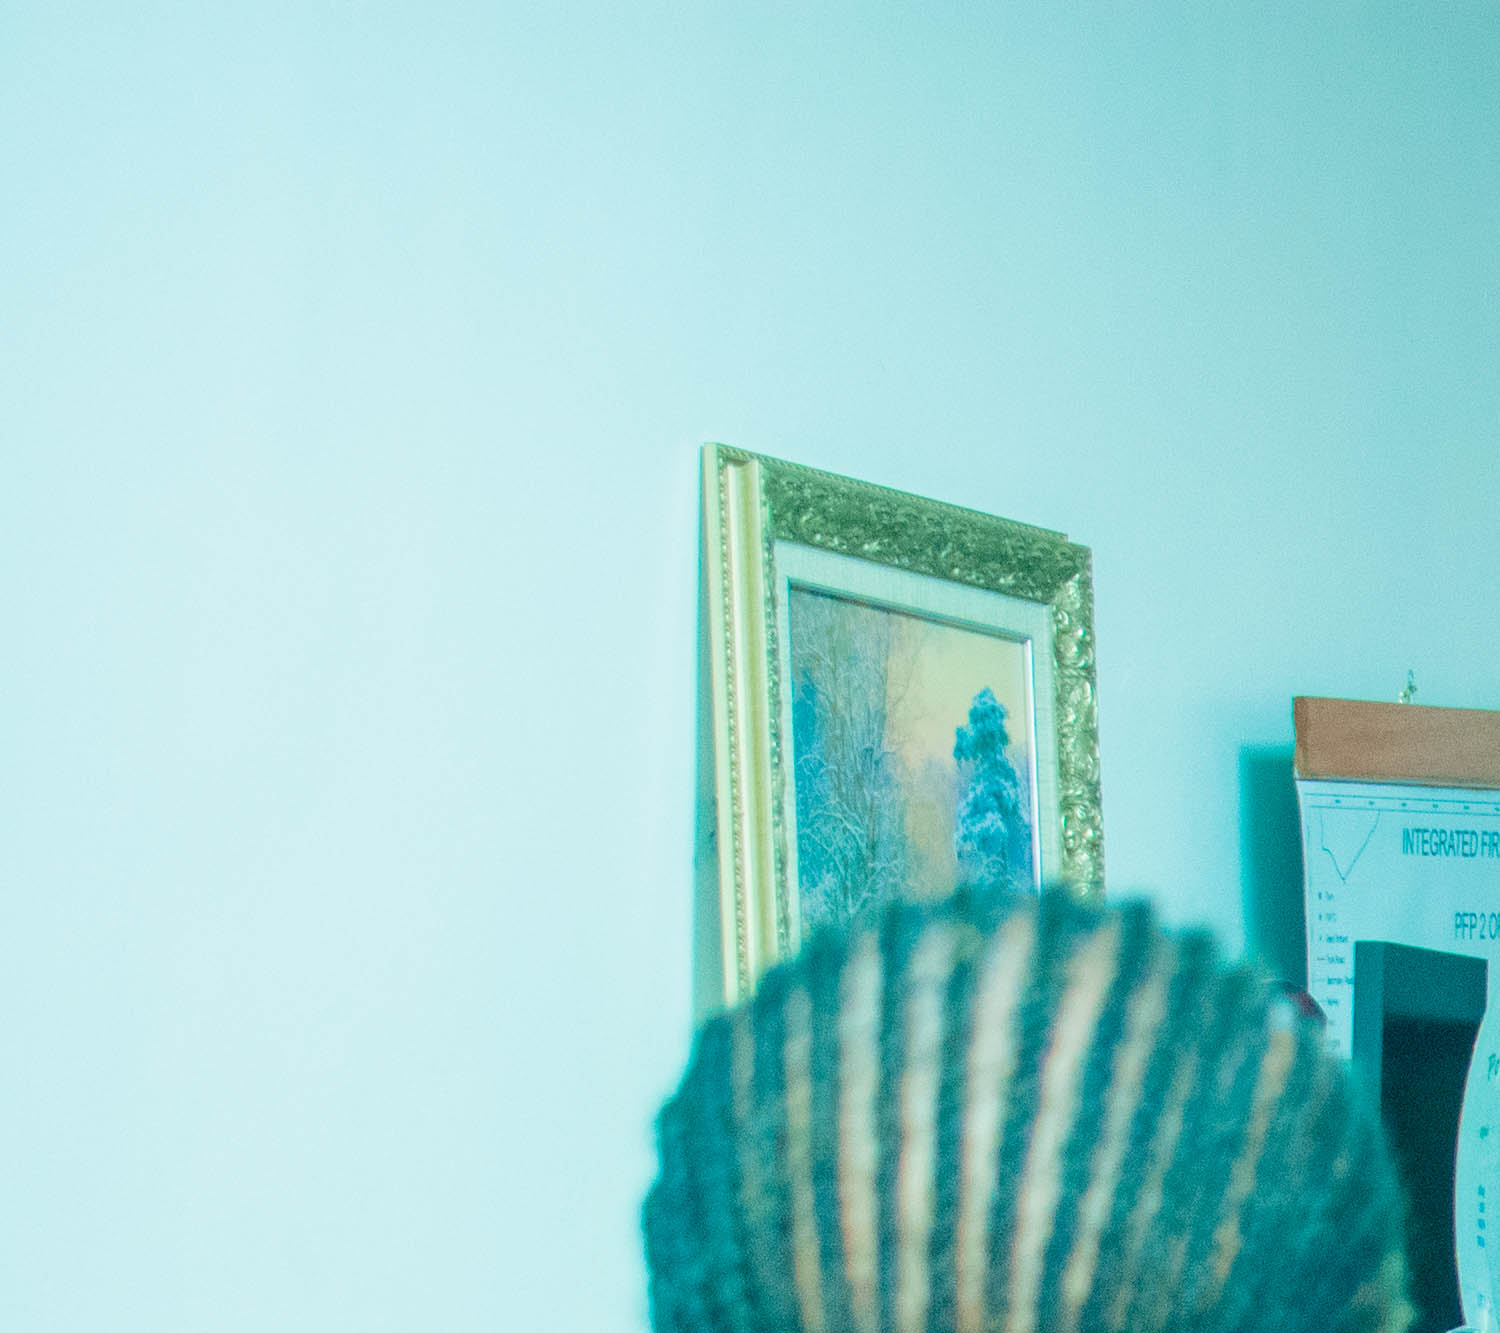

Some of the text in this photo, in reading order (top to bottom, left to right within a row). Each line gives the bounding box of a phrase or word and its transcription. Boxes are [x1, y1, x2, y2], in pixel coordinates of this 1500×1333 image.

[1402, 827, 1479, 858] INTEGRATED
[1454, 911, 1478, 941] PFP
[1479, 912, 1487, 941] 2
